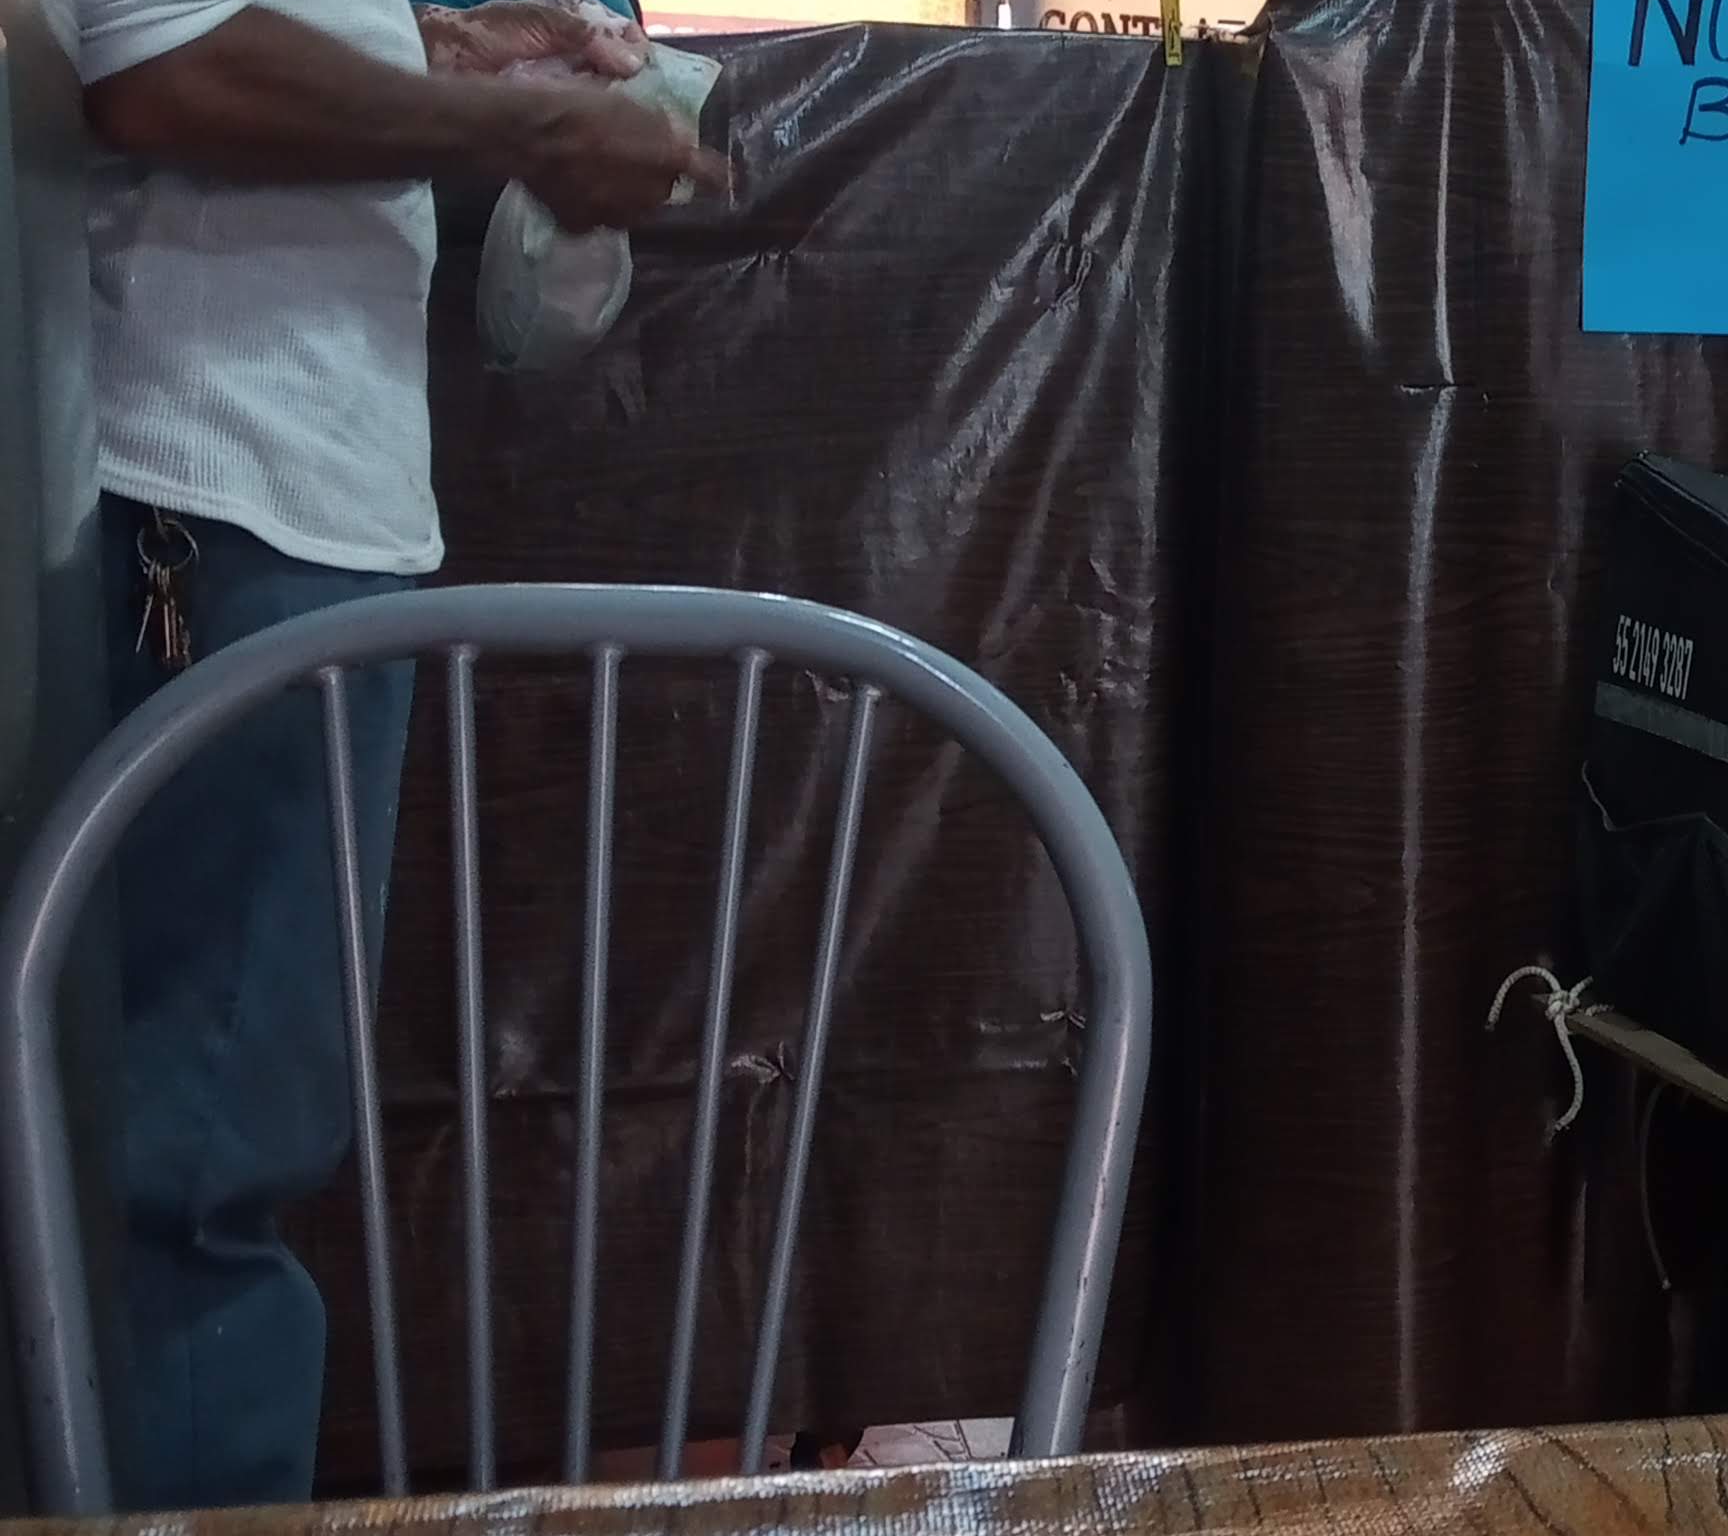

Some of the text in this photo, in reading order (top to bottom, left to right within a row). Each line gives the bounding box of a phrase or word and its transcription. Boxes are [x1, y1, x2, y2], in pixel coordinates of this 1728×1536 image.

[1612, 614, 1694, 701] 55 2149 3287
